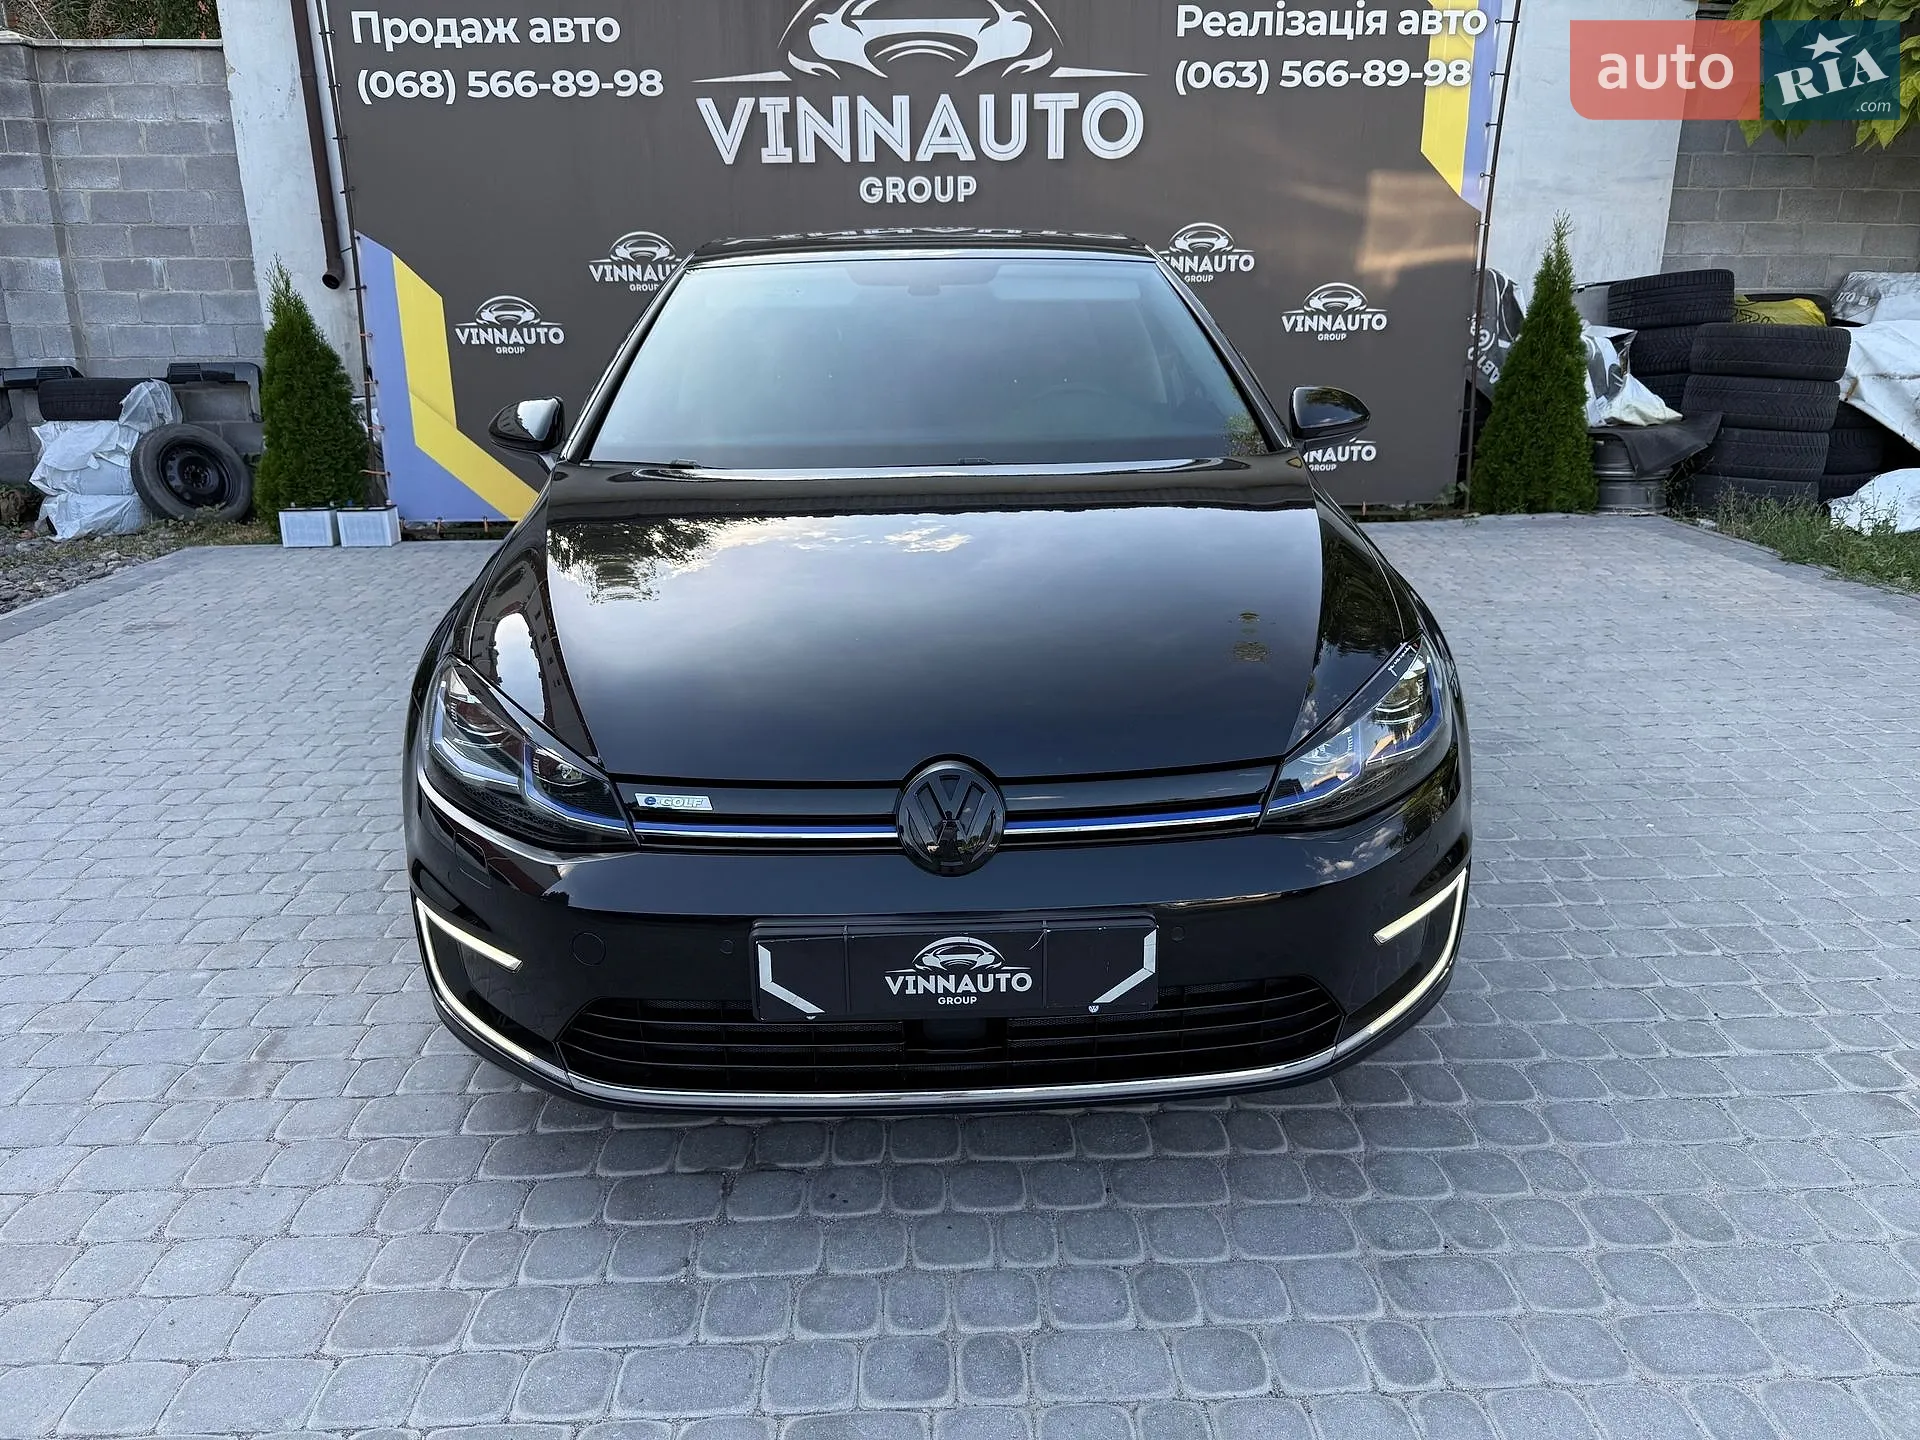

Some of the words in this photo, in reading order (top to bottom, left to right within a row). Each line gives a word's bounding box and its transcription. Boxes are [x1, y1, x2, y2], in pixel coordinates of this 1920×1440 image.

[1176, 0, 1388, 40] Реалізація
[1397, 8, 1487, 36] авто
[351, 11, 520, 51] Продаж
[528, 14, 621, 44] авто
[357, 69, 456, 104] (068)
[467, 69, 664, 99] 566-89-98
[1175, 59, 1269, 95] (063)
[1279, 59, 1471, 88] 566-89-98
[695, 90, 1144, 165] VINNAUTO
[859, 175, 977, 203] GROUP
[588, 263, 677, 282] VINNAU
[1164, 254, 1255, 273] NNAUTO
[1184, 274, 1214, 283] GROUP
[1281, 313, 1388, 333] VINNAUTO
[455, 327, 565, 345] VINNAUTO
[1317, 333, 1346, 341] GROUP
[496, 346, 525, 354] GROUP
[885, 971, 1033, 996] VINNAUTO
[938, 995, 978, 1005] GROUP
